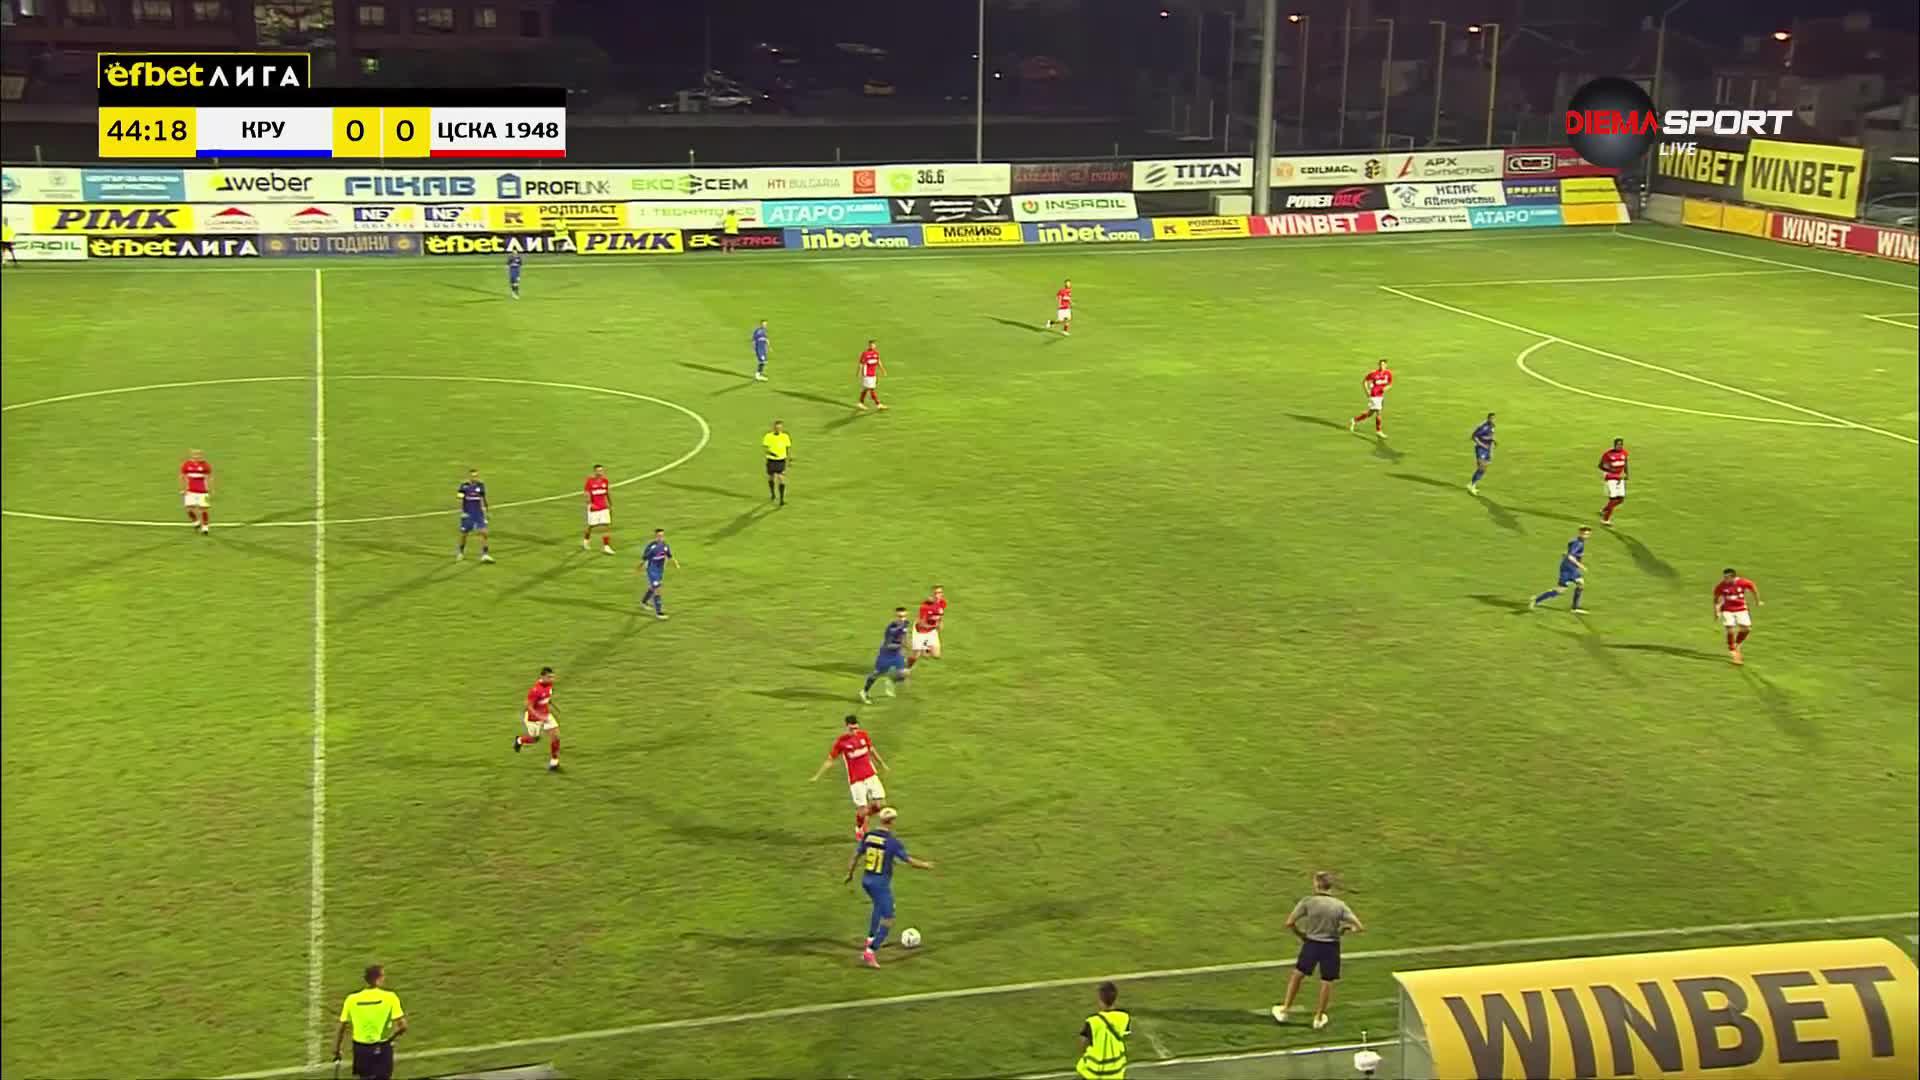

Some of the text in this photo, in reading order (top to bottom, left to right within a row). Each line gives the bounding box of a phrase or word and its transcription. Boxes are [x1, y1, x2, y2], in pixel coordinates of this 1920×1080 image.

[917, 169, 945, 185] 36.6
[1174, 162, 1242, 178] TITAN
[1656, 148, 1744, 187] WINBET
[1750, 154, 1856, 200] WINBET
[230, 172, 313, 192] weber
[345, 176, 476, 196] FILKAB
[52, 208, 180, 230] PIMK
[1264, 212, 1358, 236] WINBET
[584, 232, 676, 250] PIMK
[801, 228, 908, 249] inbet.com
[1038, 223, 1140, 243] inbet.com
[1782, 216, 1851, 249] WINBET
[327, 234, 390, 253] ГОДИНИ
[1878, 230, 1919, 259] WIN
[1442, 966, 1895, 1080] WINBET
